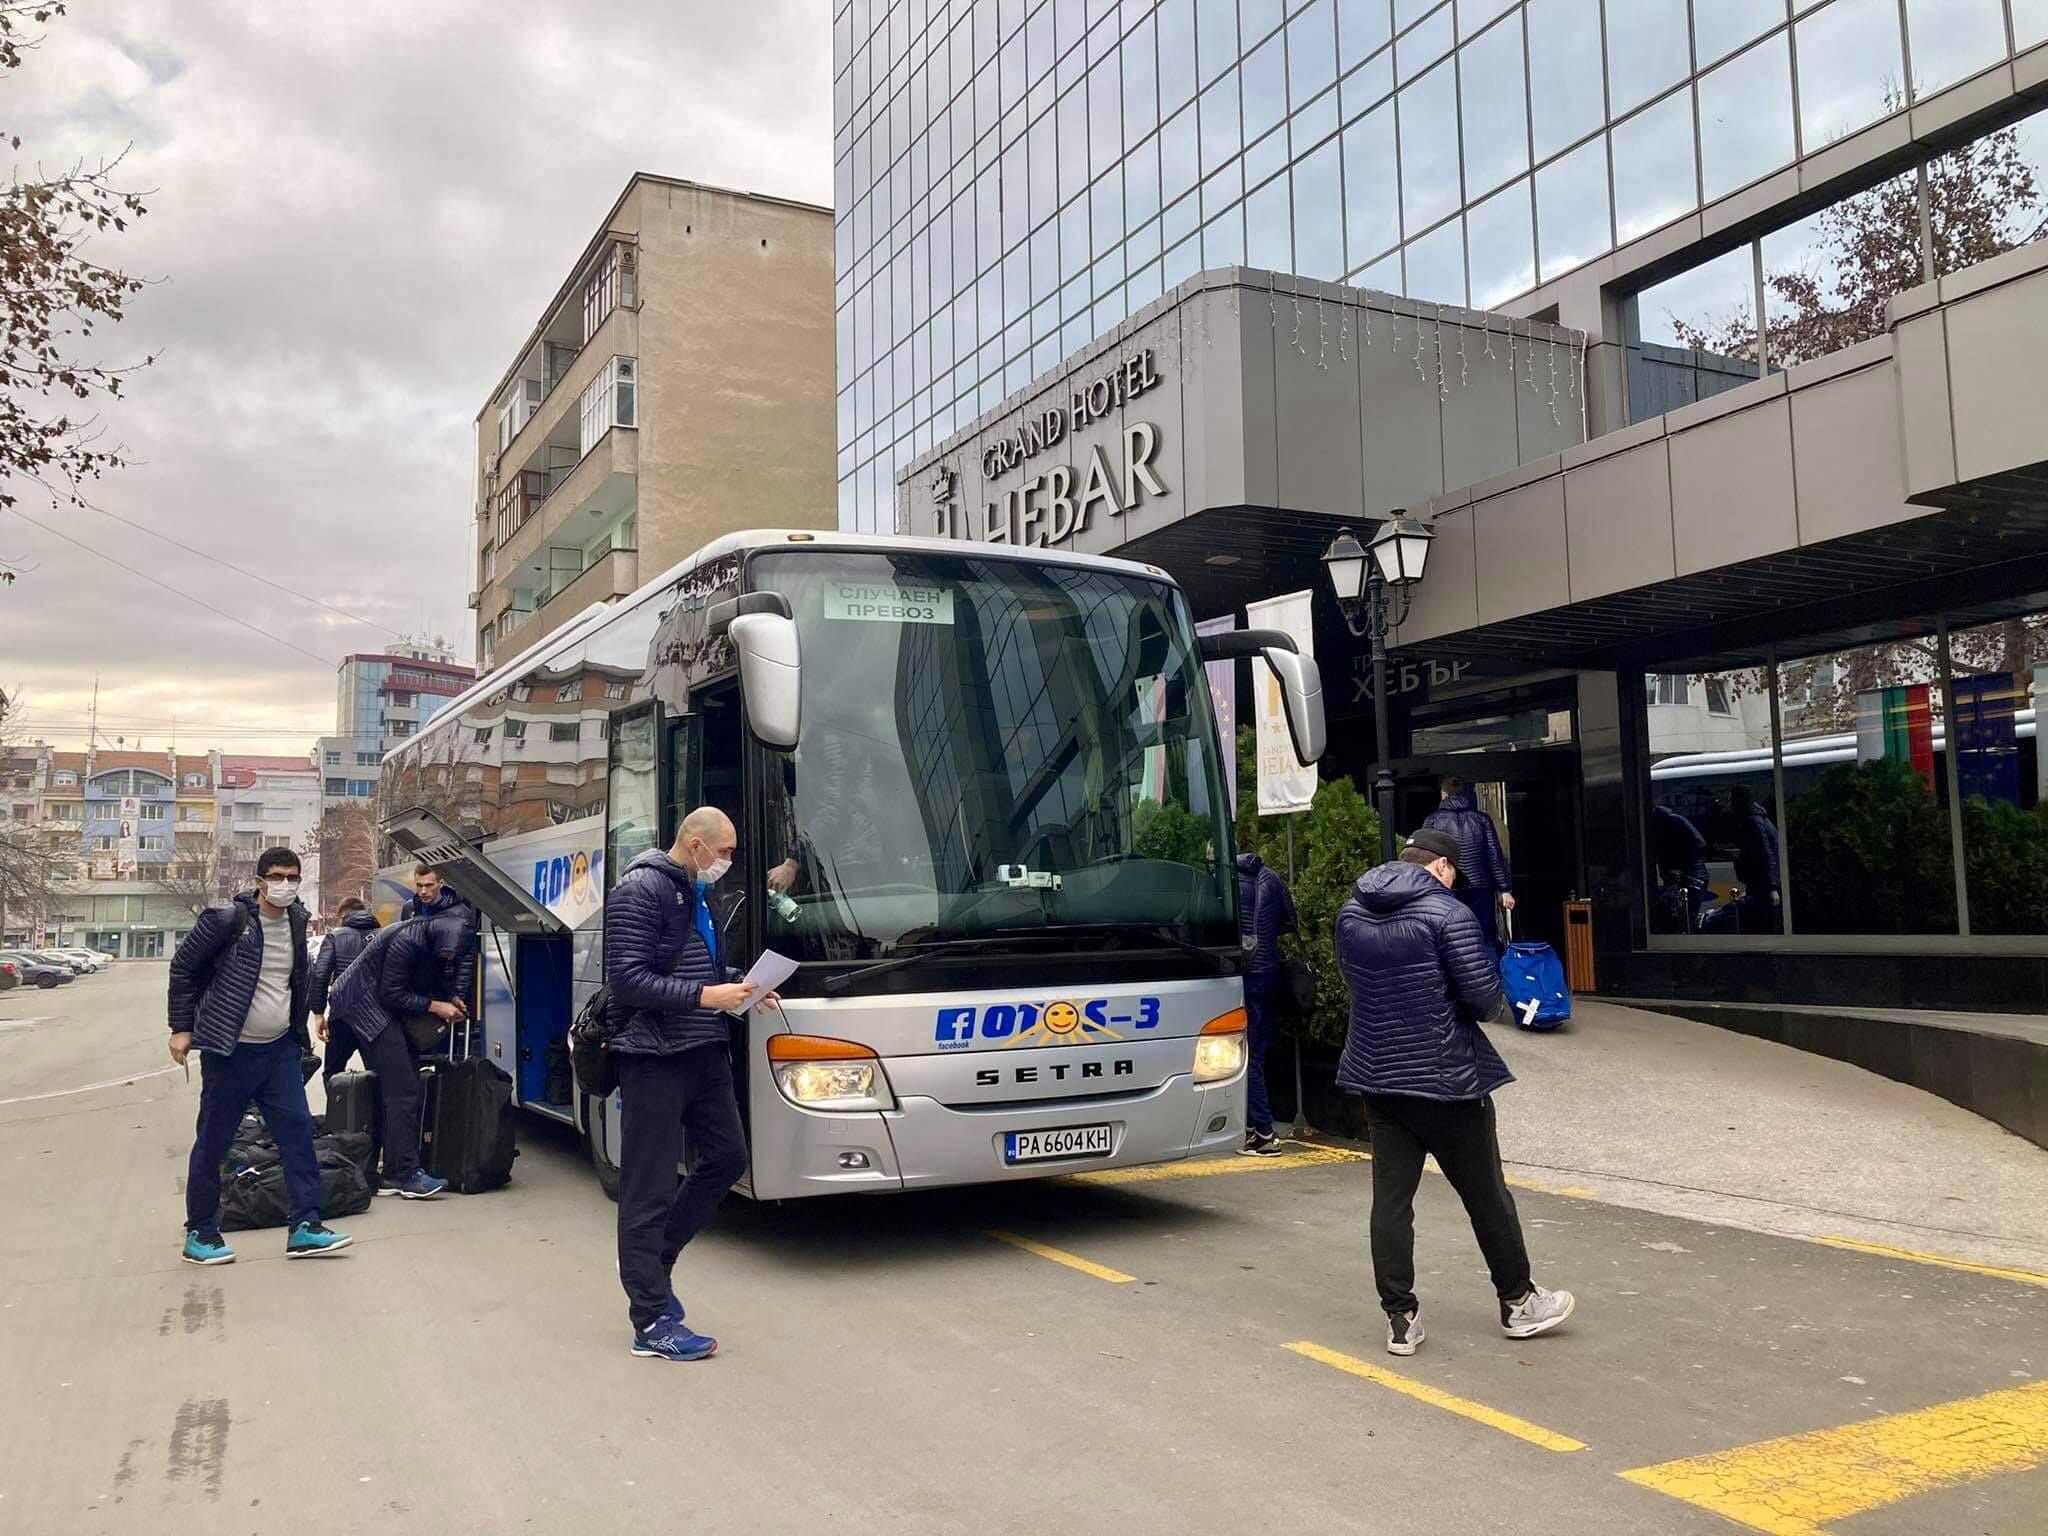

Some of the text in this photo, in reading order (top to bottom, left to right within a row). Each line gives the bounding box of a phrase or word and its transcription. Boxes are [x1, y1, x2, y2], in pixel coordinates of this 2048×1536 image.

[981, 349, 1158, 479] GRAND HOTEL
[982, 422, 1167, 547] HEBAR
[839, 586, 940, 604] СЛУЧАЕН
[847, 604, 935, 619] ПРЕВОЗ
[938, 1041, 970, 1049] facebook
[976, 1060, 1134, 1086] SETRA
